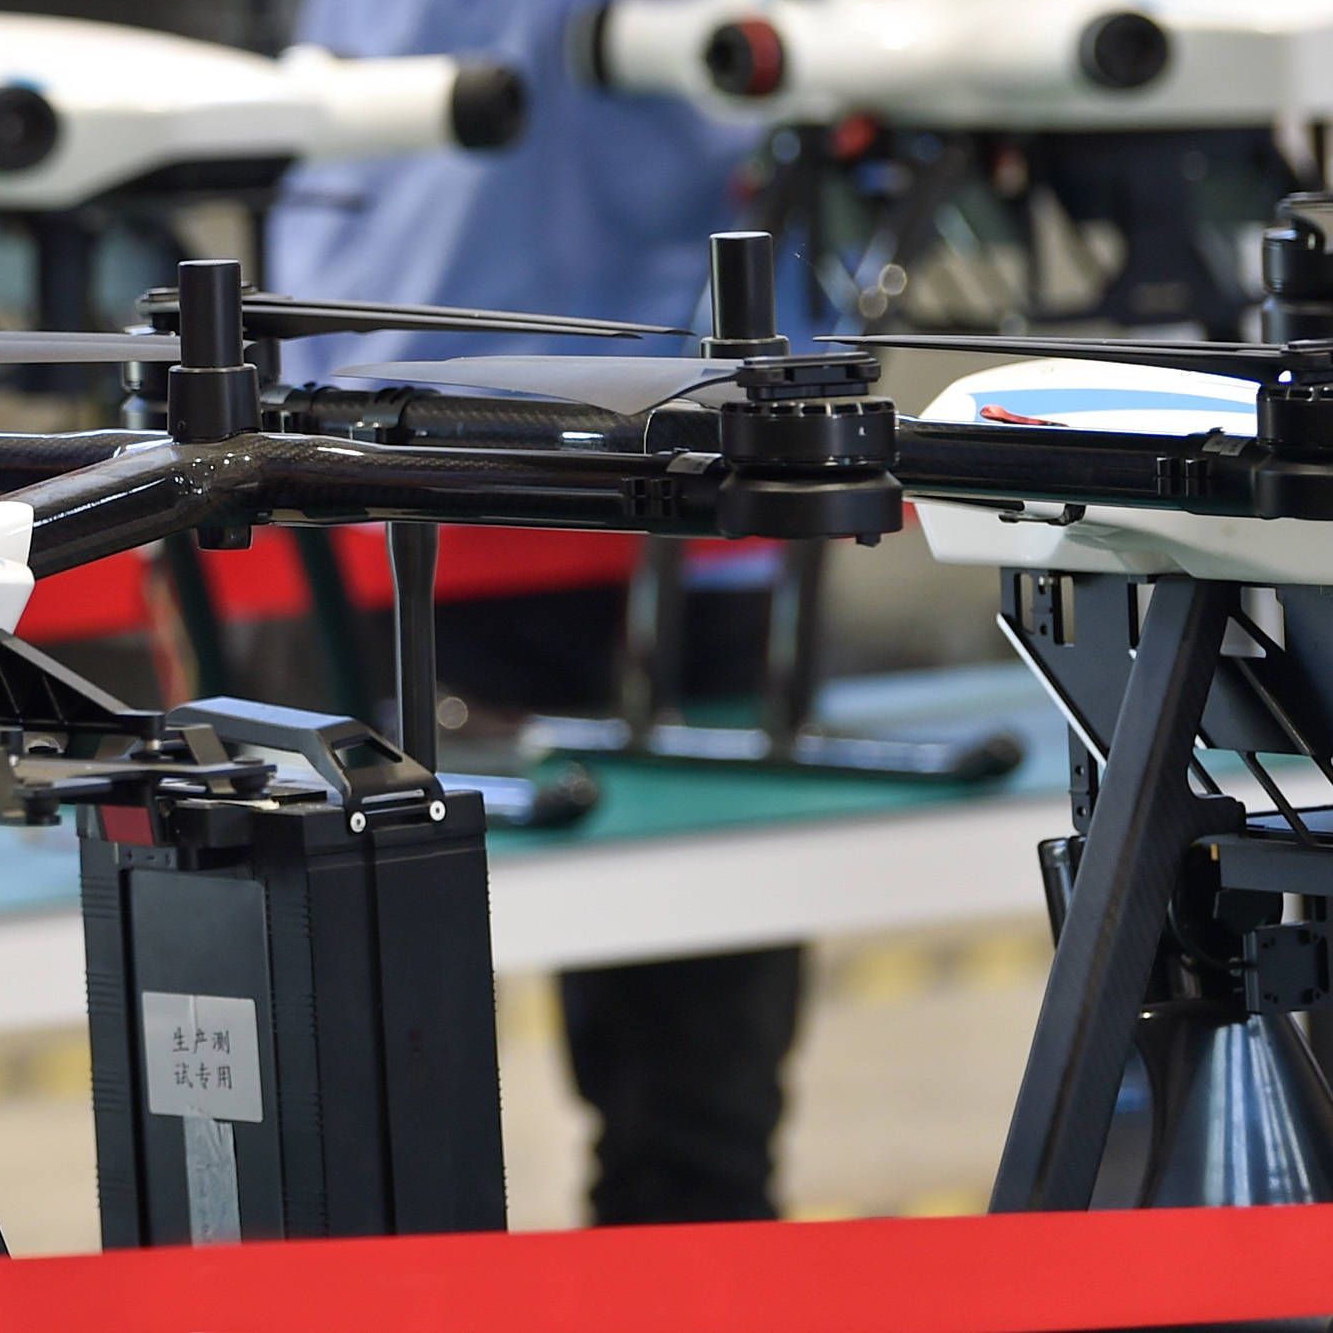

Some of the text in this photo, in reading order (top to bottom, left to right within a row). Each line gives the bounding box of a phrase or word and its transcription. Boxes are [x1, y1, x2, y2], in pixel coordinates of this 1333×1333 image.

[172, 1027, 229, 1054] 生产测
[174, 1062, 232, 1089] 试专用
